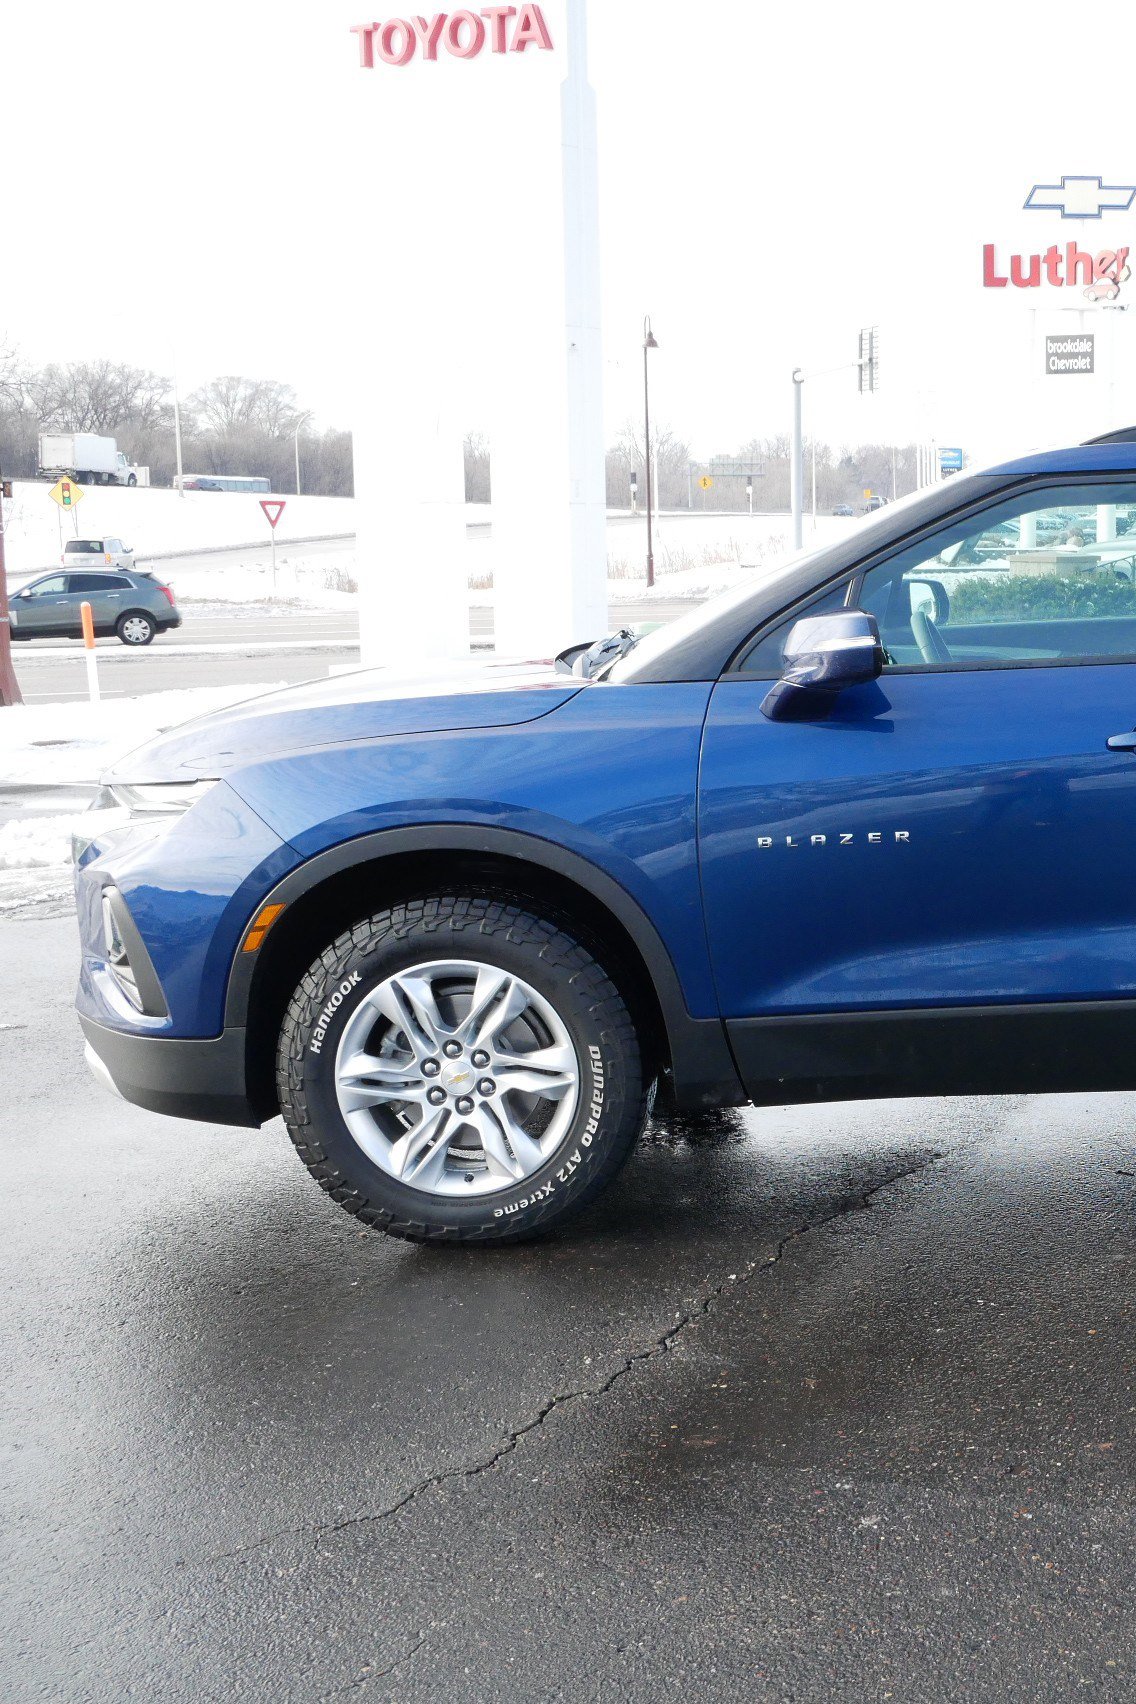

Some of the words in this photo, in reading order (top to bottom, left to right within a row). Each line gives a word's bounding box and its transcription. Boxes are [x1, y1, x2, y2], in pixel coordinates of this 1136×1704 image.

[350, 3, 554, 68] TOYOTA
[983, 241, 1130, 288] Luther
[1047, 338, 1093, 353] brookdale
[1049, 355, 1091, 370] Chevrolet
[757, 830, 910, 849] BLAZER
[556, 1148, 583, 1183] AT2
[493, 1185, 556, 1218] Xtreme
